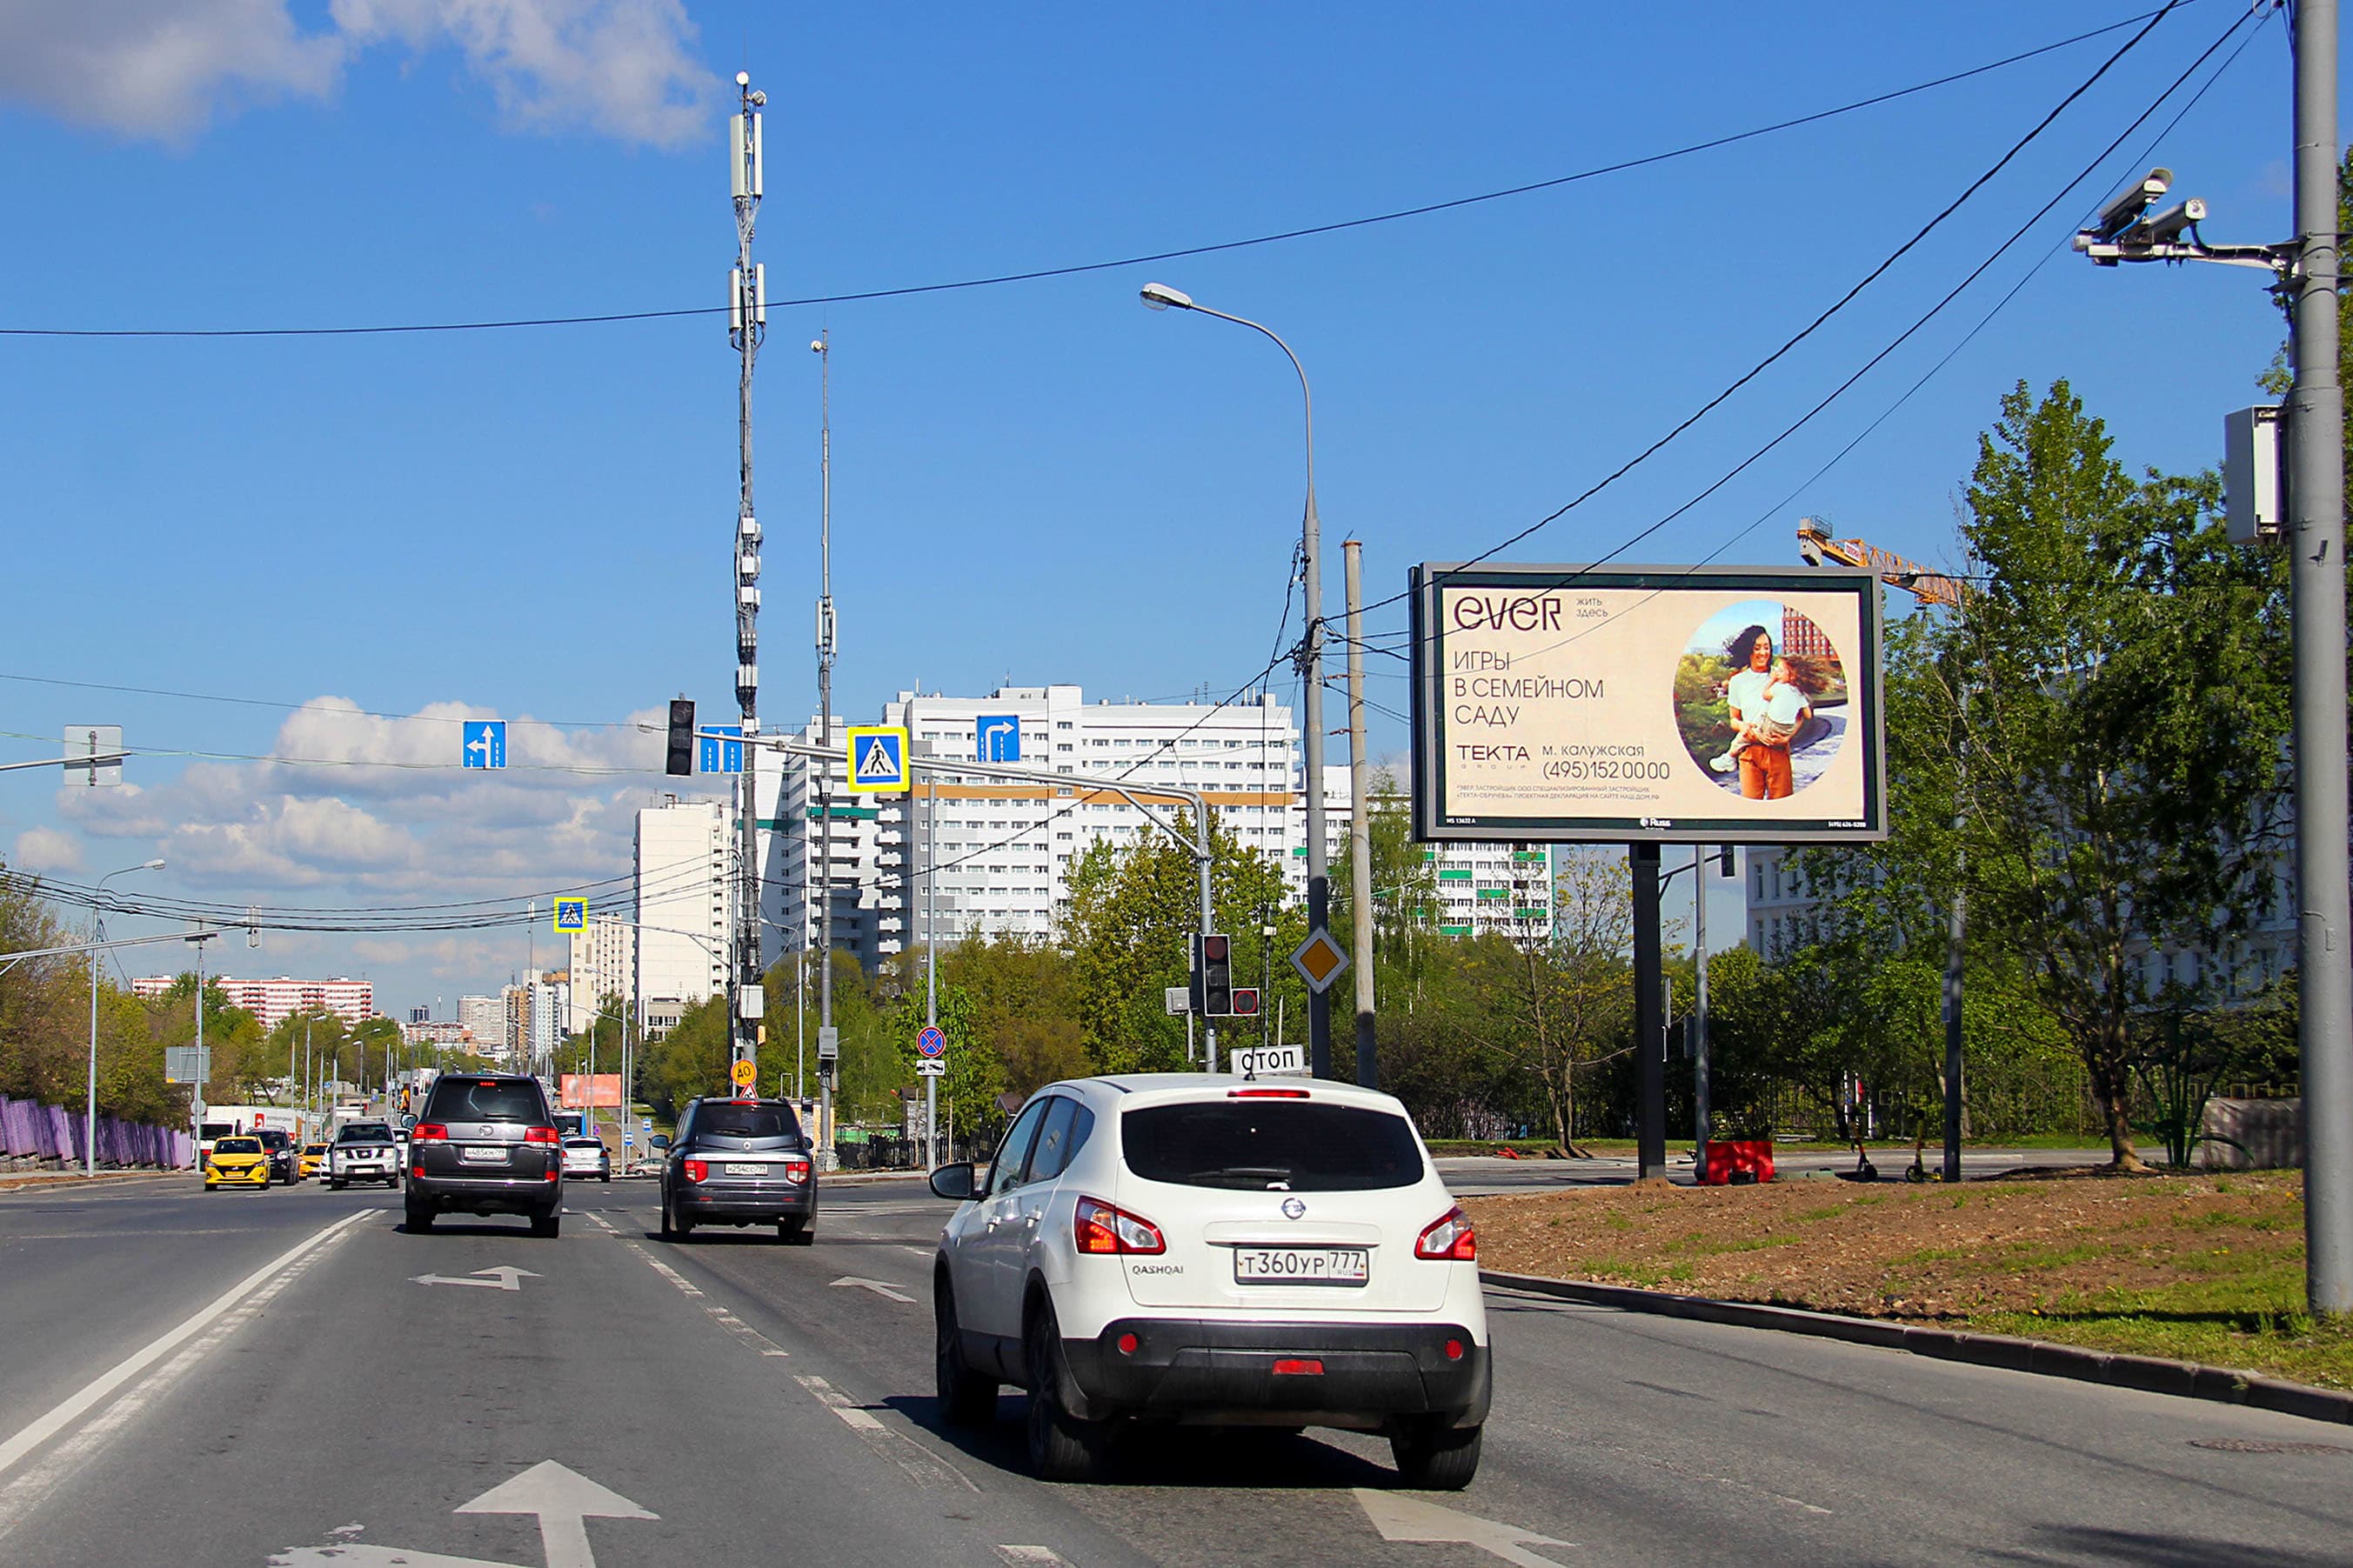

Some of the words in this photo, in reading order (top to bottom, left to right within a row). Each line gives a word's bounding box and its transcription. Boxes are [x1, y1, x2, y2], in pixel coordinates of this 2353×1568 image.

[1575, 597, 1602, 607] жить
[1575, 608, 1608, 618] здесь
[1454, 651, 1510, 671] ИГРЫ
[1454, 677, 1467, 697] В
[1472, 674, 1604, 698] СЕМЕЙНОМ
[1454, 704, 1521, 728] САДУ
[1456, 744, 1531, 761] ТЕКТА
[1241, 1051, 1294, 1071] СТОП
[1133, 1264, 1184, 1276] QASHQAI
[1244, 1251, 1325, 1274] Т360УР
[1329, 1251, 1360, 1269] 777
